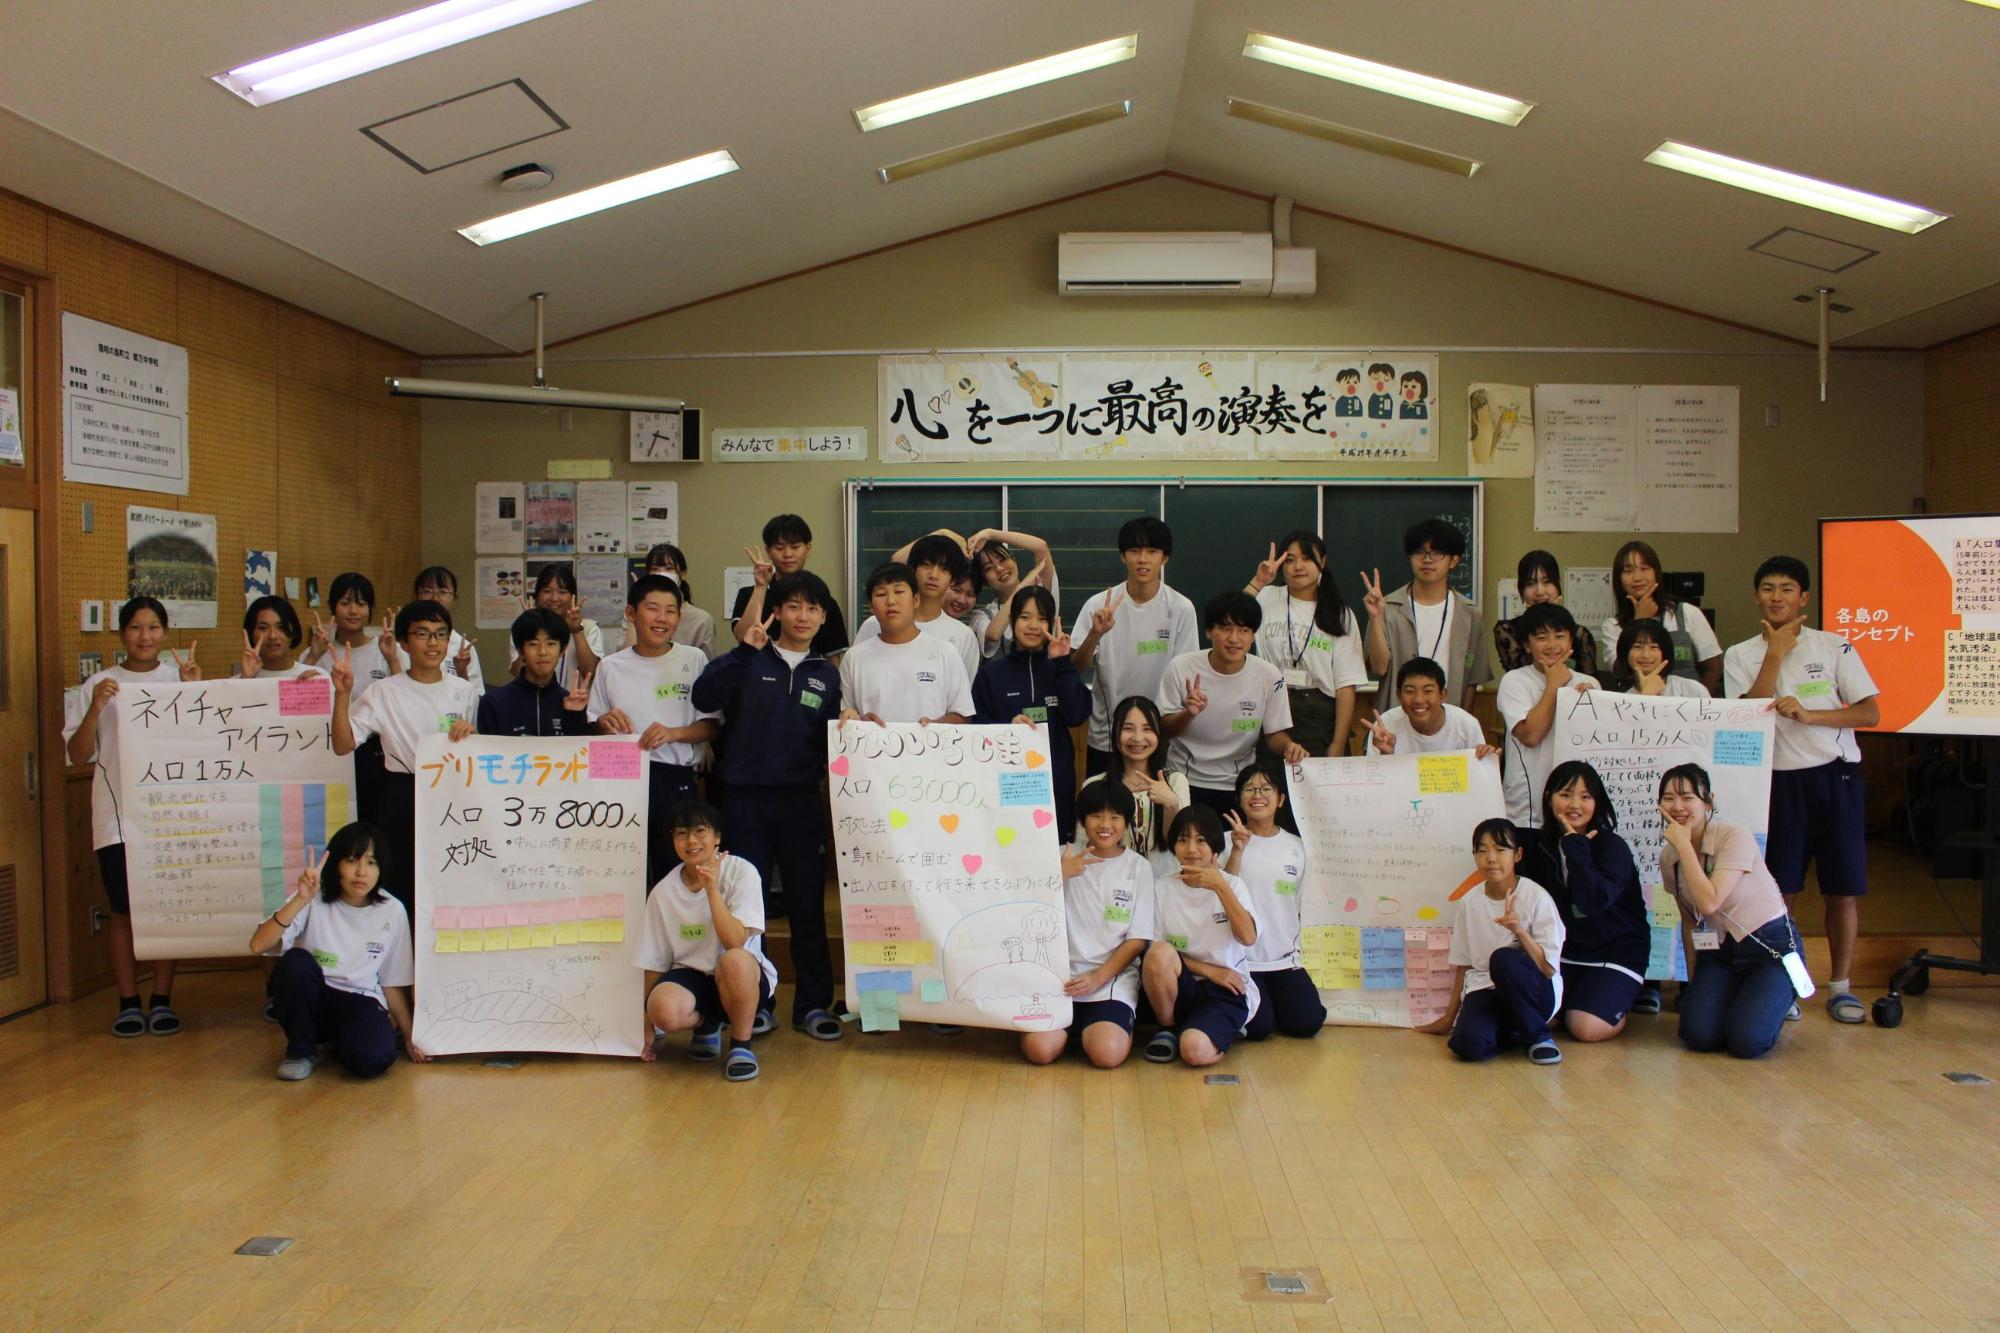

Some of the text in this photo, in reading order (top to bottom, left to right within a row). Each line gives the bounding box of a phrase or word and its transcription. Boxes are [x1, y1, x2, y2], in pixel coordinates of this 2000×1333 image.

[890, 377, 1331, 444] 心を一つに最高の演奏を
[721, 436, 852, 453] みんなで集中しよう！
[1835, 608, 1888, 624] 各島の
[1836, 626, 1915, 642] コンセプト
[131, 689, 268, 728] ネイチャー
[1567, 689, 1598, 721] A
[422, 747, 588, 788] ブリモチランド
[1292, 764, 1304, 783] B
[837, 777, 872, 798] 人口
[440, 803, 482, 826] 人口
[440, 837, 496, 872] 対処
